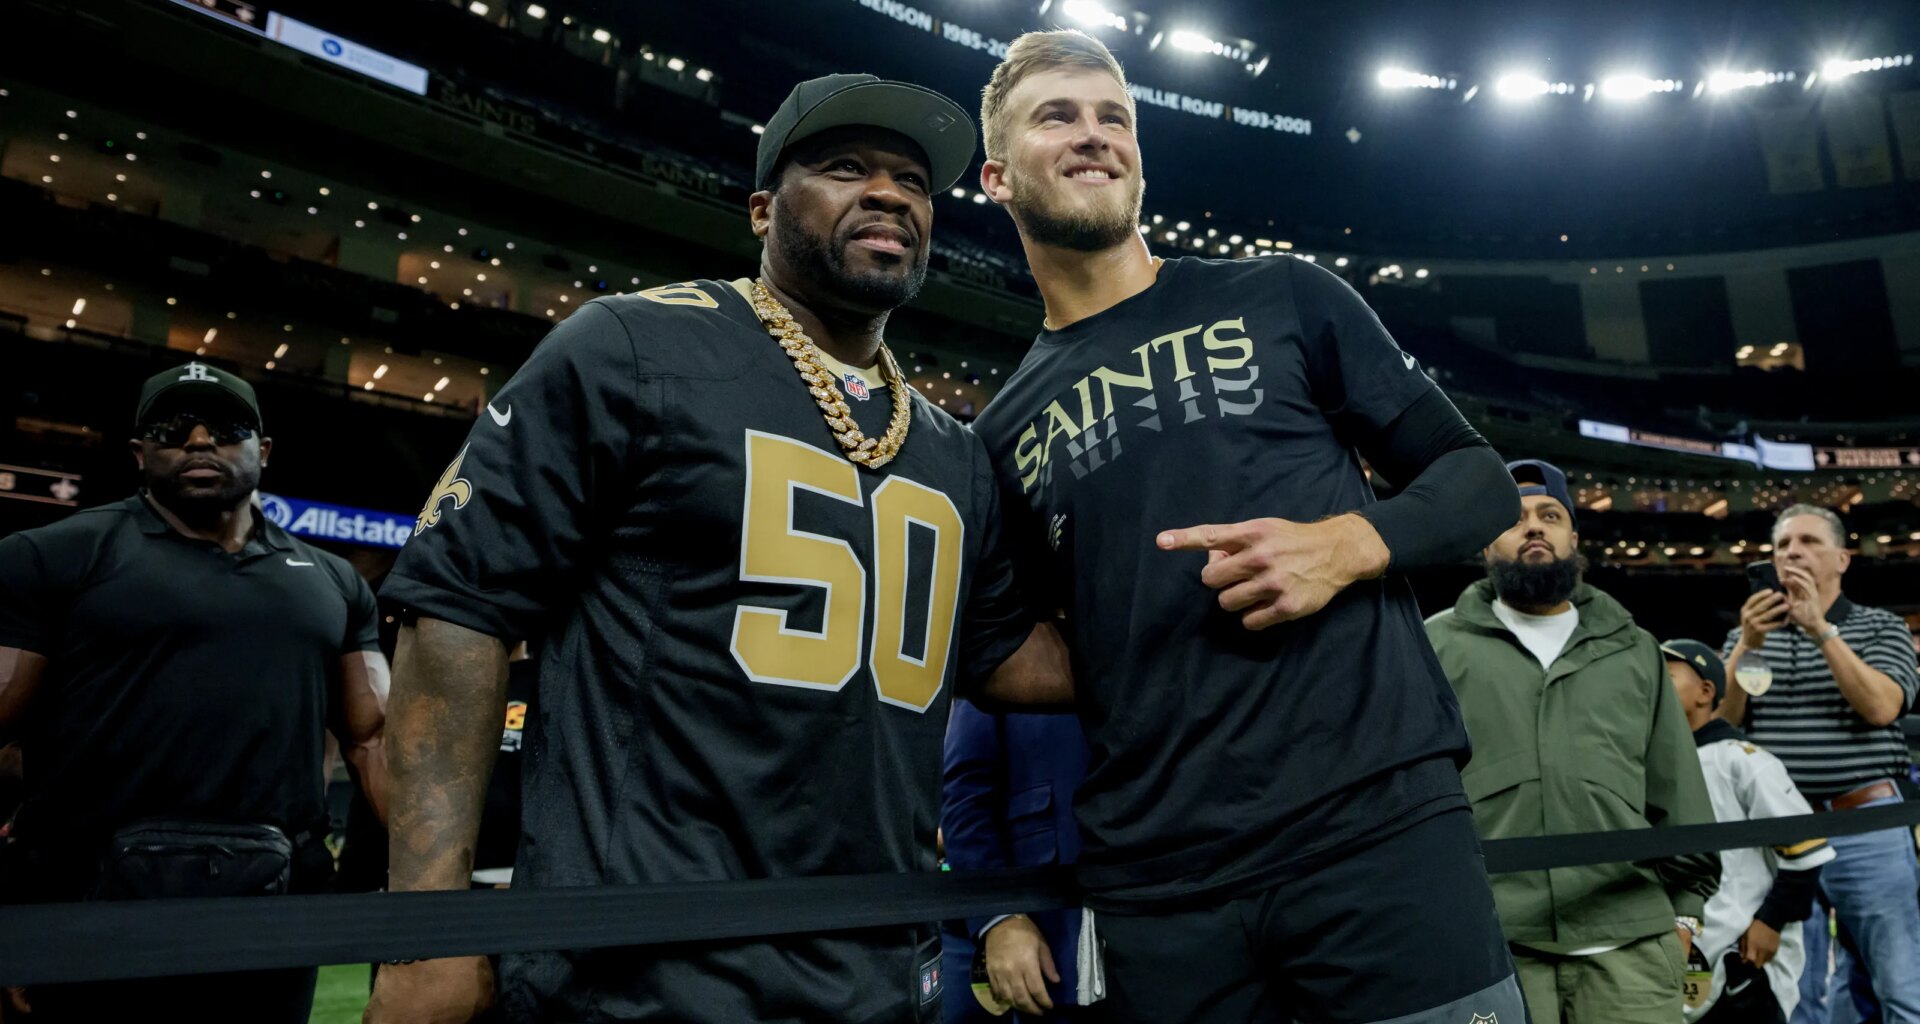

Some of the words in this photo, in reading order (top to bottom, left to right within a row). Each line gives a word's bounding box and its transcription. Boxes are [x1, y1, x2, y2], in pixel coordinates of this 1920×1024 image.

[942, 21, 1010, 59] 1985-20
[1129, 84, 1180, 110] WILLIE
[1181, 95, 1224, 119] ROAF
[1232, 106, 1312, 136] 1993-2001
[1014, 316, 1254, 495] SAINTS
[289, 507, 413, 547] Allstate
[729, 428, 965, 714] 50
